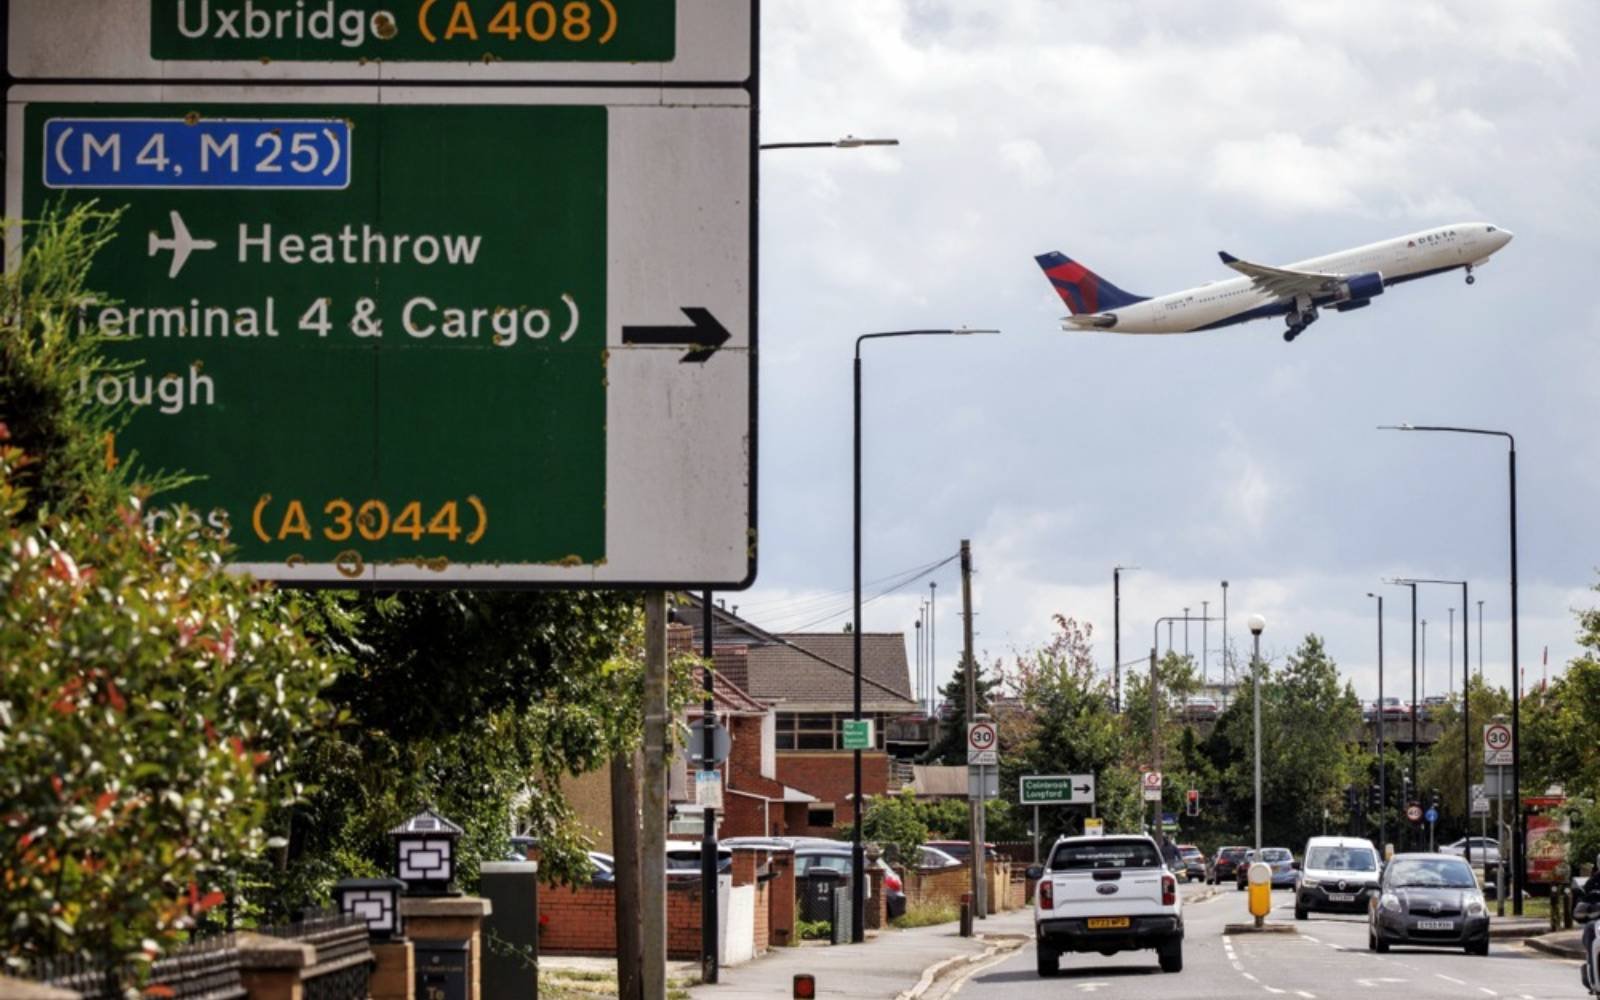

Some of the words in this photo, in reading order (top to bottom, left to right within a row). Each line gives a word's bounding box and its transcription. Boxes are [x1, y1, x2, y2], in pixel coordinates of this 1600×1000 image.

[178, 0, 396, 47] Uxbridge
[239, 223, 481, 264] Heathrow
[298, 297, 333, 337] 4
[349, 297, 384, 337] &
[974, 731, 991, 742] 30
[1490, 732, 1508, 743] 30
[1026, 790, 1063, 799] Longford
